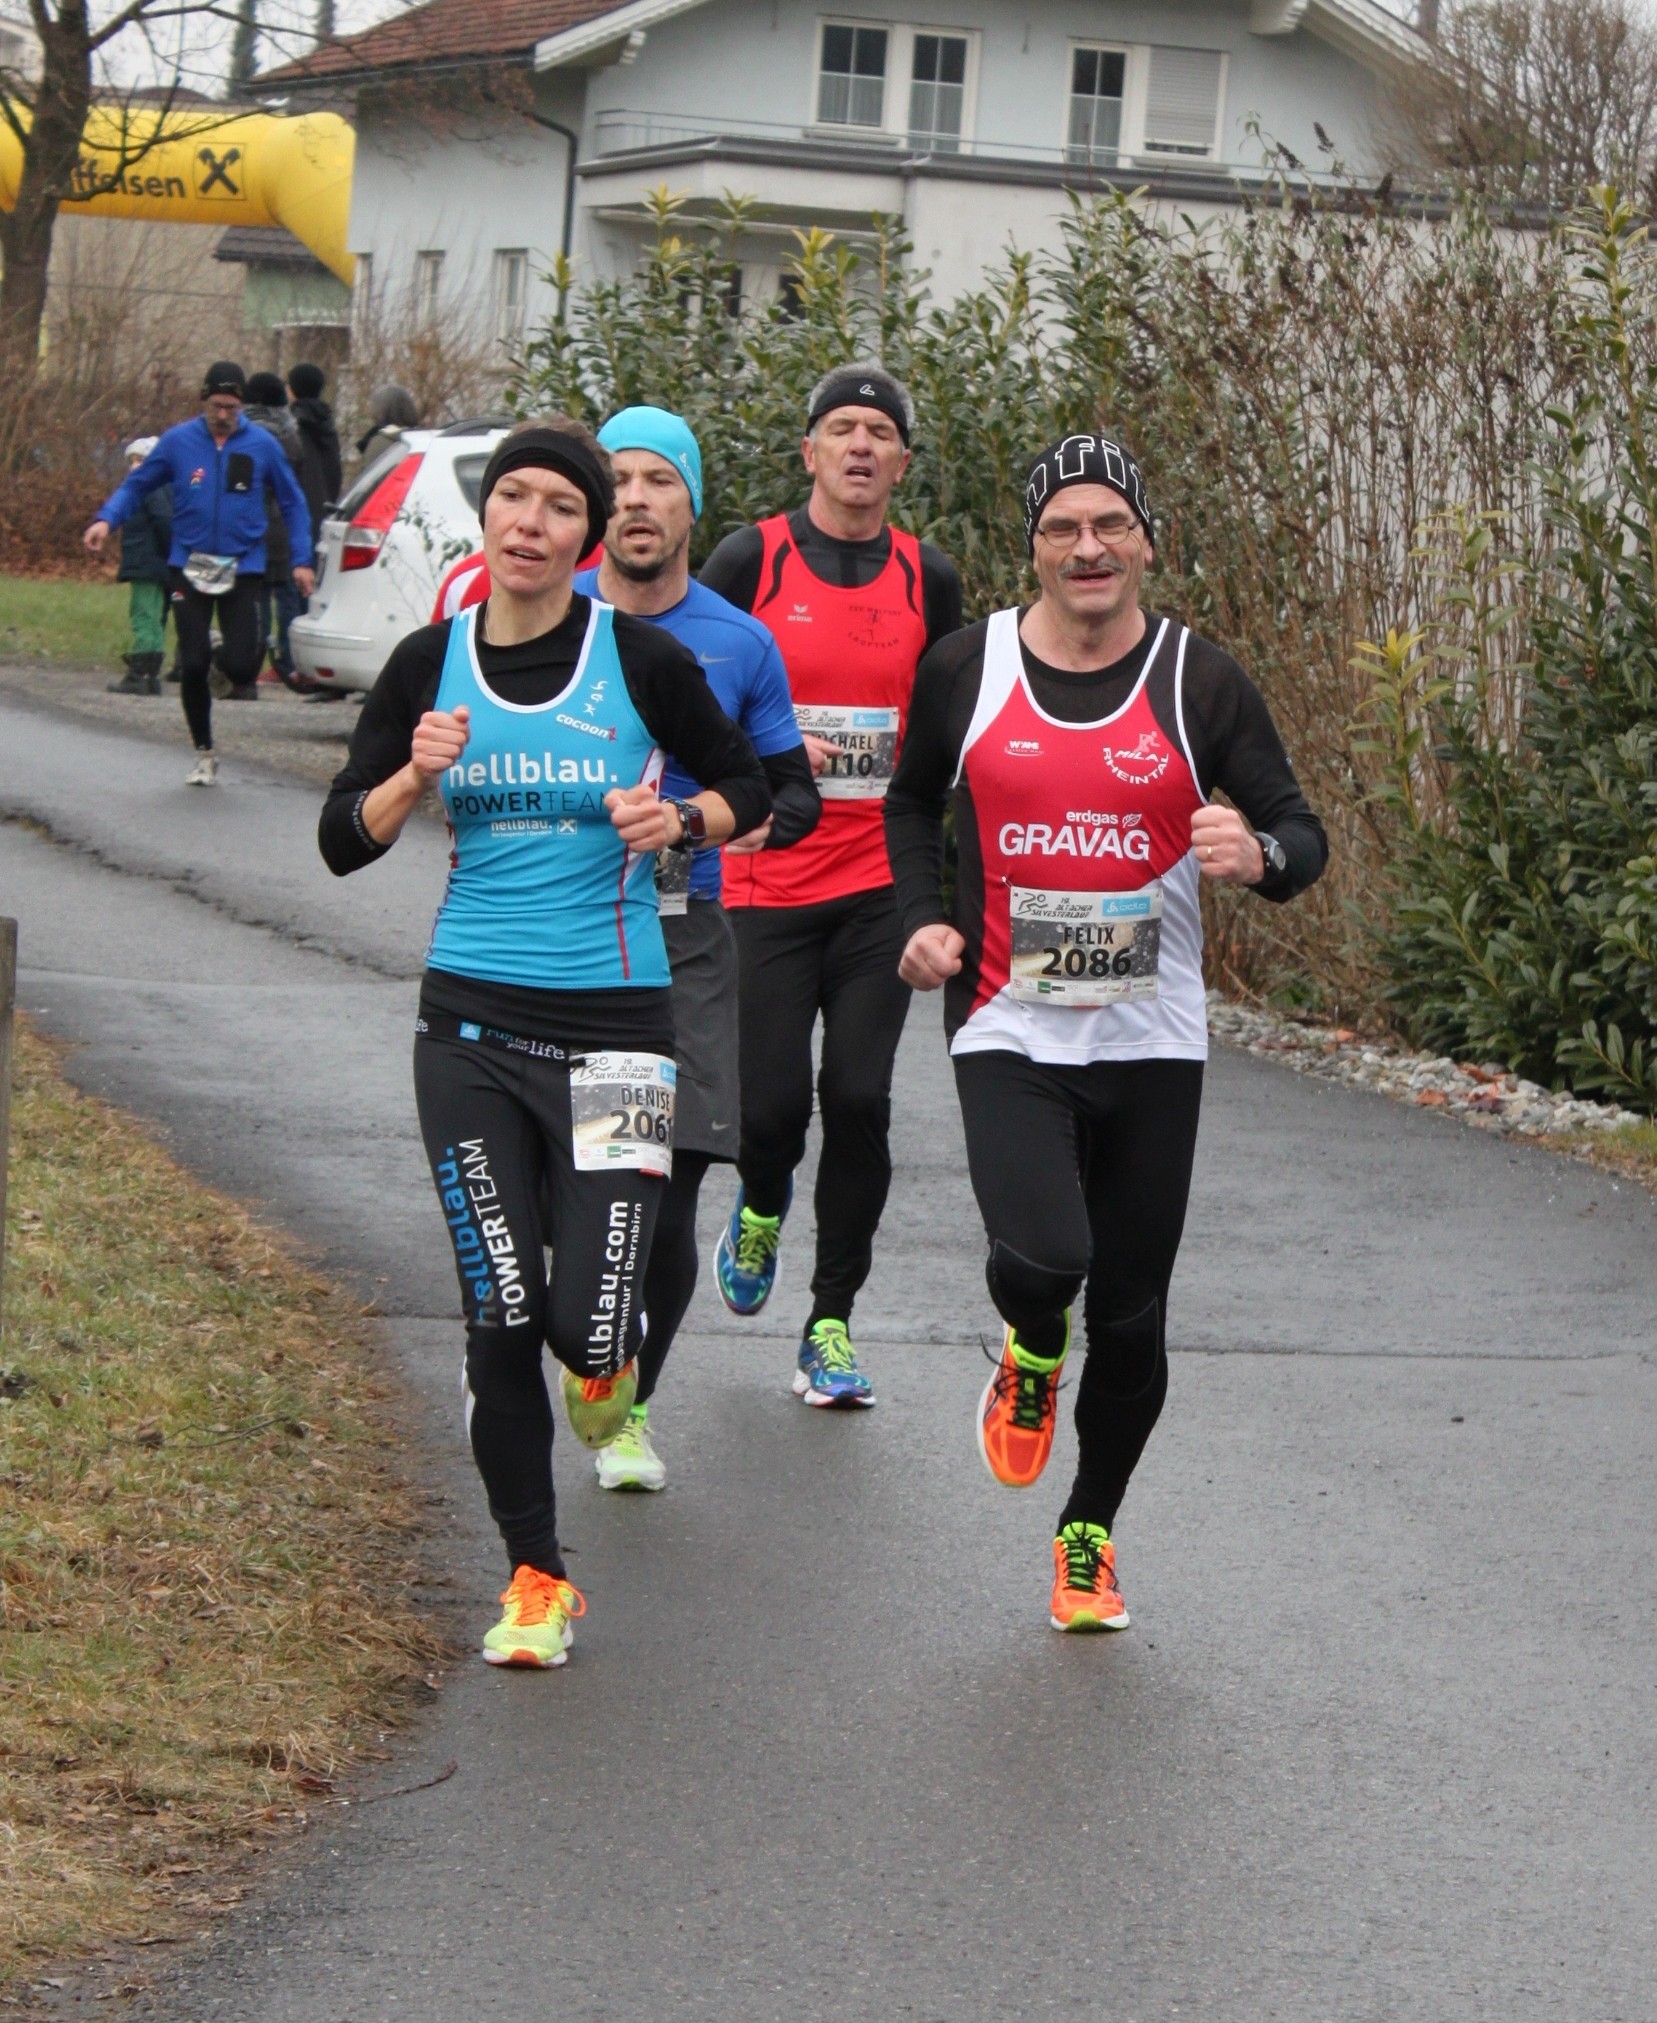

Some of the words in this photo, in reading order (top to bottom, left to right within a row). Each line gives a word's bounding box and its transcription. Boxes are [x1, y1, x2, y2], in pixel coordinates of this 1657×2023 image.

[1102, 747, 1169, 784] RHEINTAL
[1066, 809, 1119, 826] erdgas
[998, 822, 1150, 861] GRAVAG
[1031, 909, 1090, 919] SILVESTERLAUF
[1063, 926, 1115, 945] FELIX
[1041, 947, 1132, 977] 2086
[528, 1040, 566, 1060] life
[621, 1087, 670, 1111] DENISE
[458, 1138, 530, 1326] POWERTEAM
[624, 1203, 642, 1270] Dornbirn
